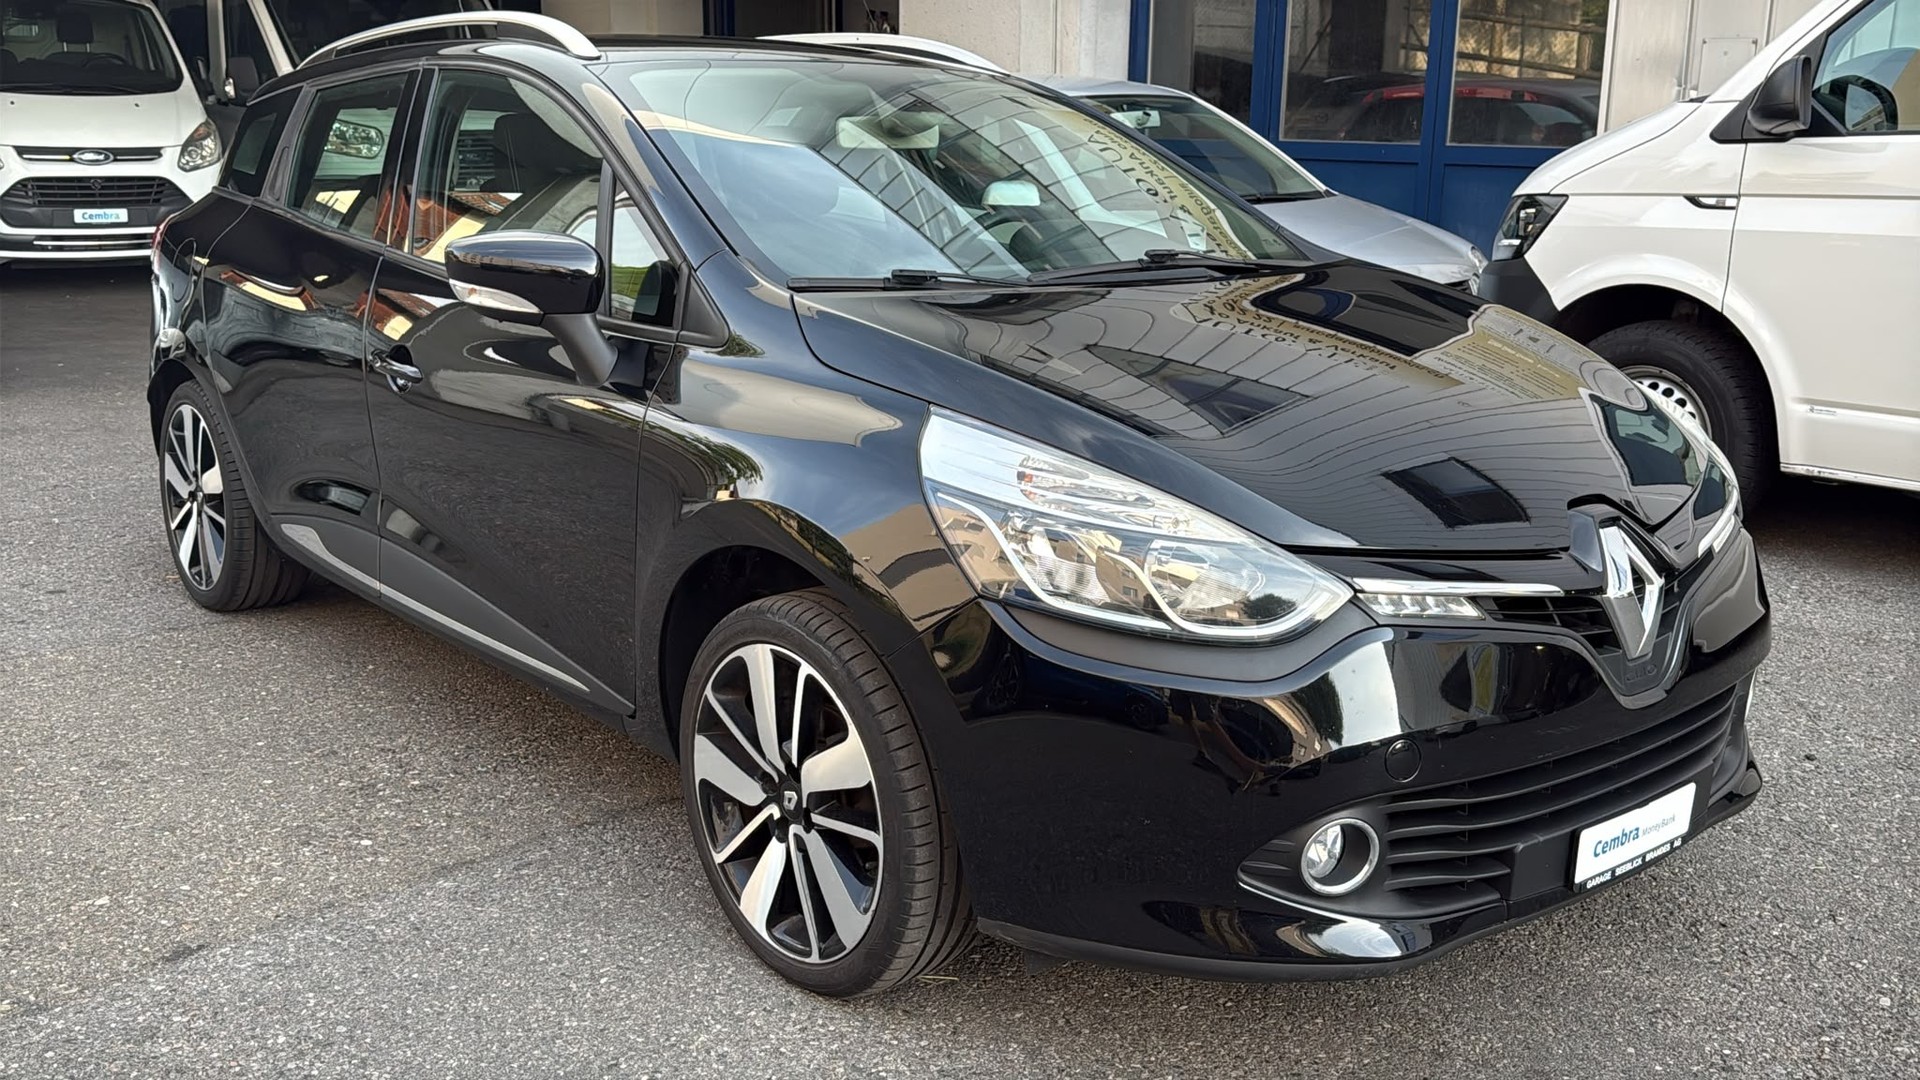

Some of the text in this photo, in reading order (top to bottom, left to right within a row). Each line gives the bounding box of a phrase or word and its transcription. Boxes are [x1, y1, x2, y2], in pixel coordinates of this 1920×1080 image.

[82, 211, 120, 220] Cembra
[1593, 814, 1676, 858] Cembra MoneyBank
[1586, 871, 1612, 889] GARAGE
[1673, 838, 1682, 848] AG
